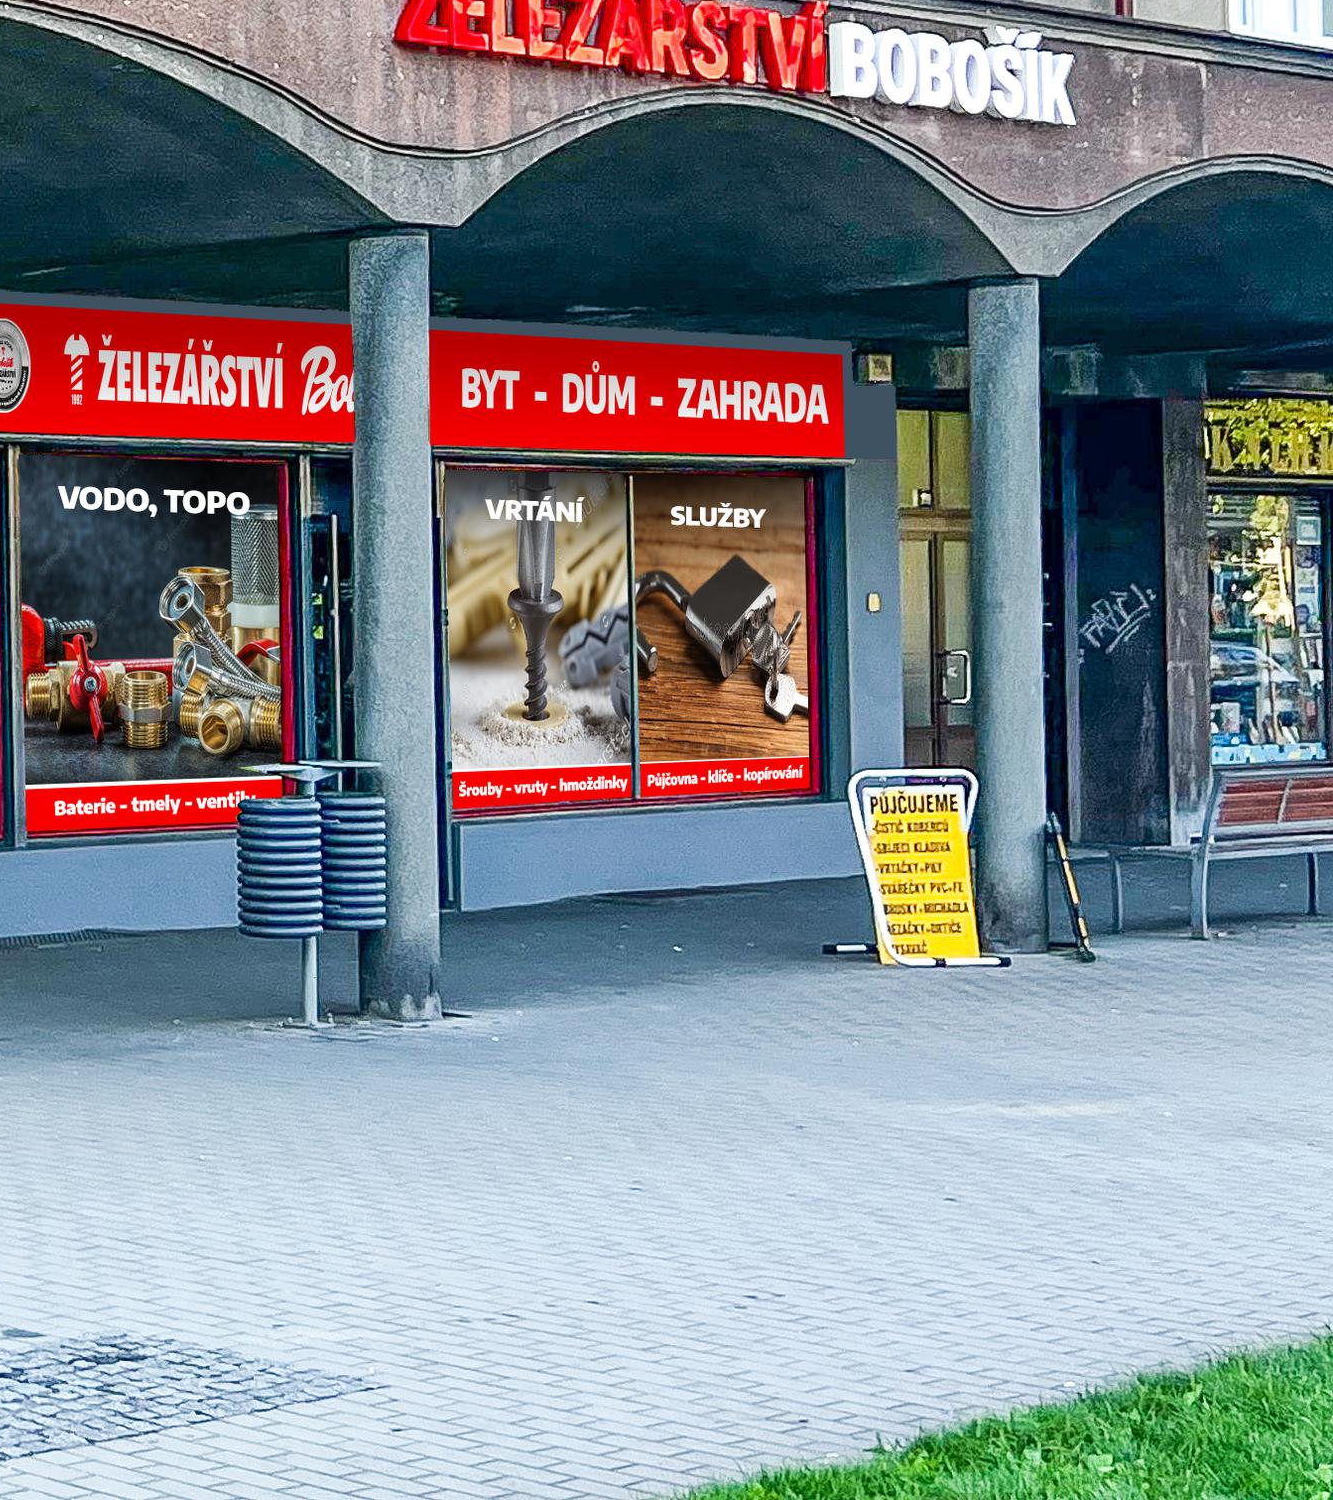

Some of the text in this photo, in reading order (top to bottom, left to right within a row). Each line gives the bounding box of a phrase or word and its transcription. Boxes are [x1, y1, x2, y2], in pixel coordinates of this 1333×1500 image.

[829, 22, 1077, 127] BOBOŠÍK
[97, 334, 283, 409] ŽELEZÁŘSTVÍ
[462, 368, 521, 410] BYT
[562, 361, 636, 416] DŮM
[678, 378, 829, 425] ZAHRADA
[58, 485, 251, 517] VODO, TOPO
[485, 496, 585, 523] VRTÁNÍ
[670, 503, 766, 530] SLUŽBY
[458, 781, 503, 798] Šrouby
[514, 780, 548, 796] vruty
[559, 775, 628, 792] hmoždinky
[647, 773, 698, 789] Půjčovna
[708, 768, 734, 784] klíče
[744, 765, 804, 784] kopírování
[54, 797, 116, 816] Baterie
[131, 794, 181, 815] tmely
[196, 790, 256, 810] ventil
